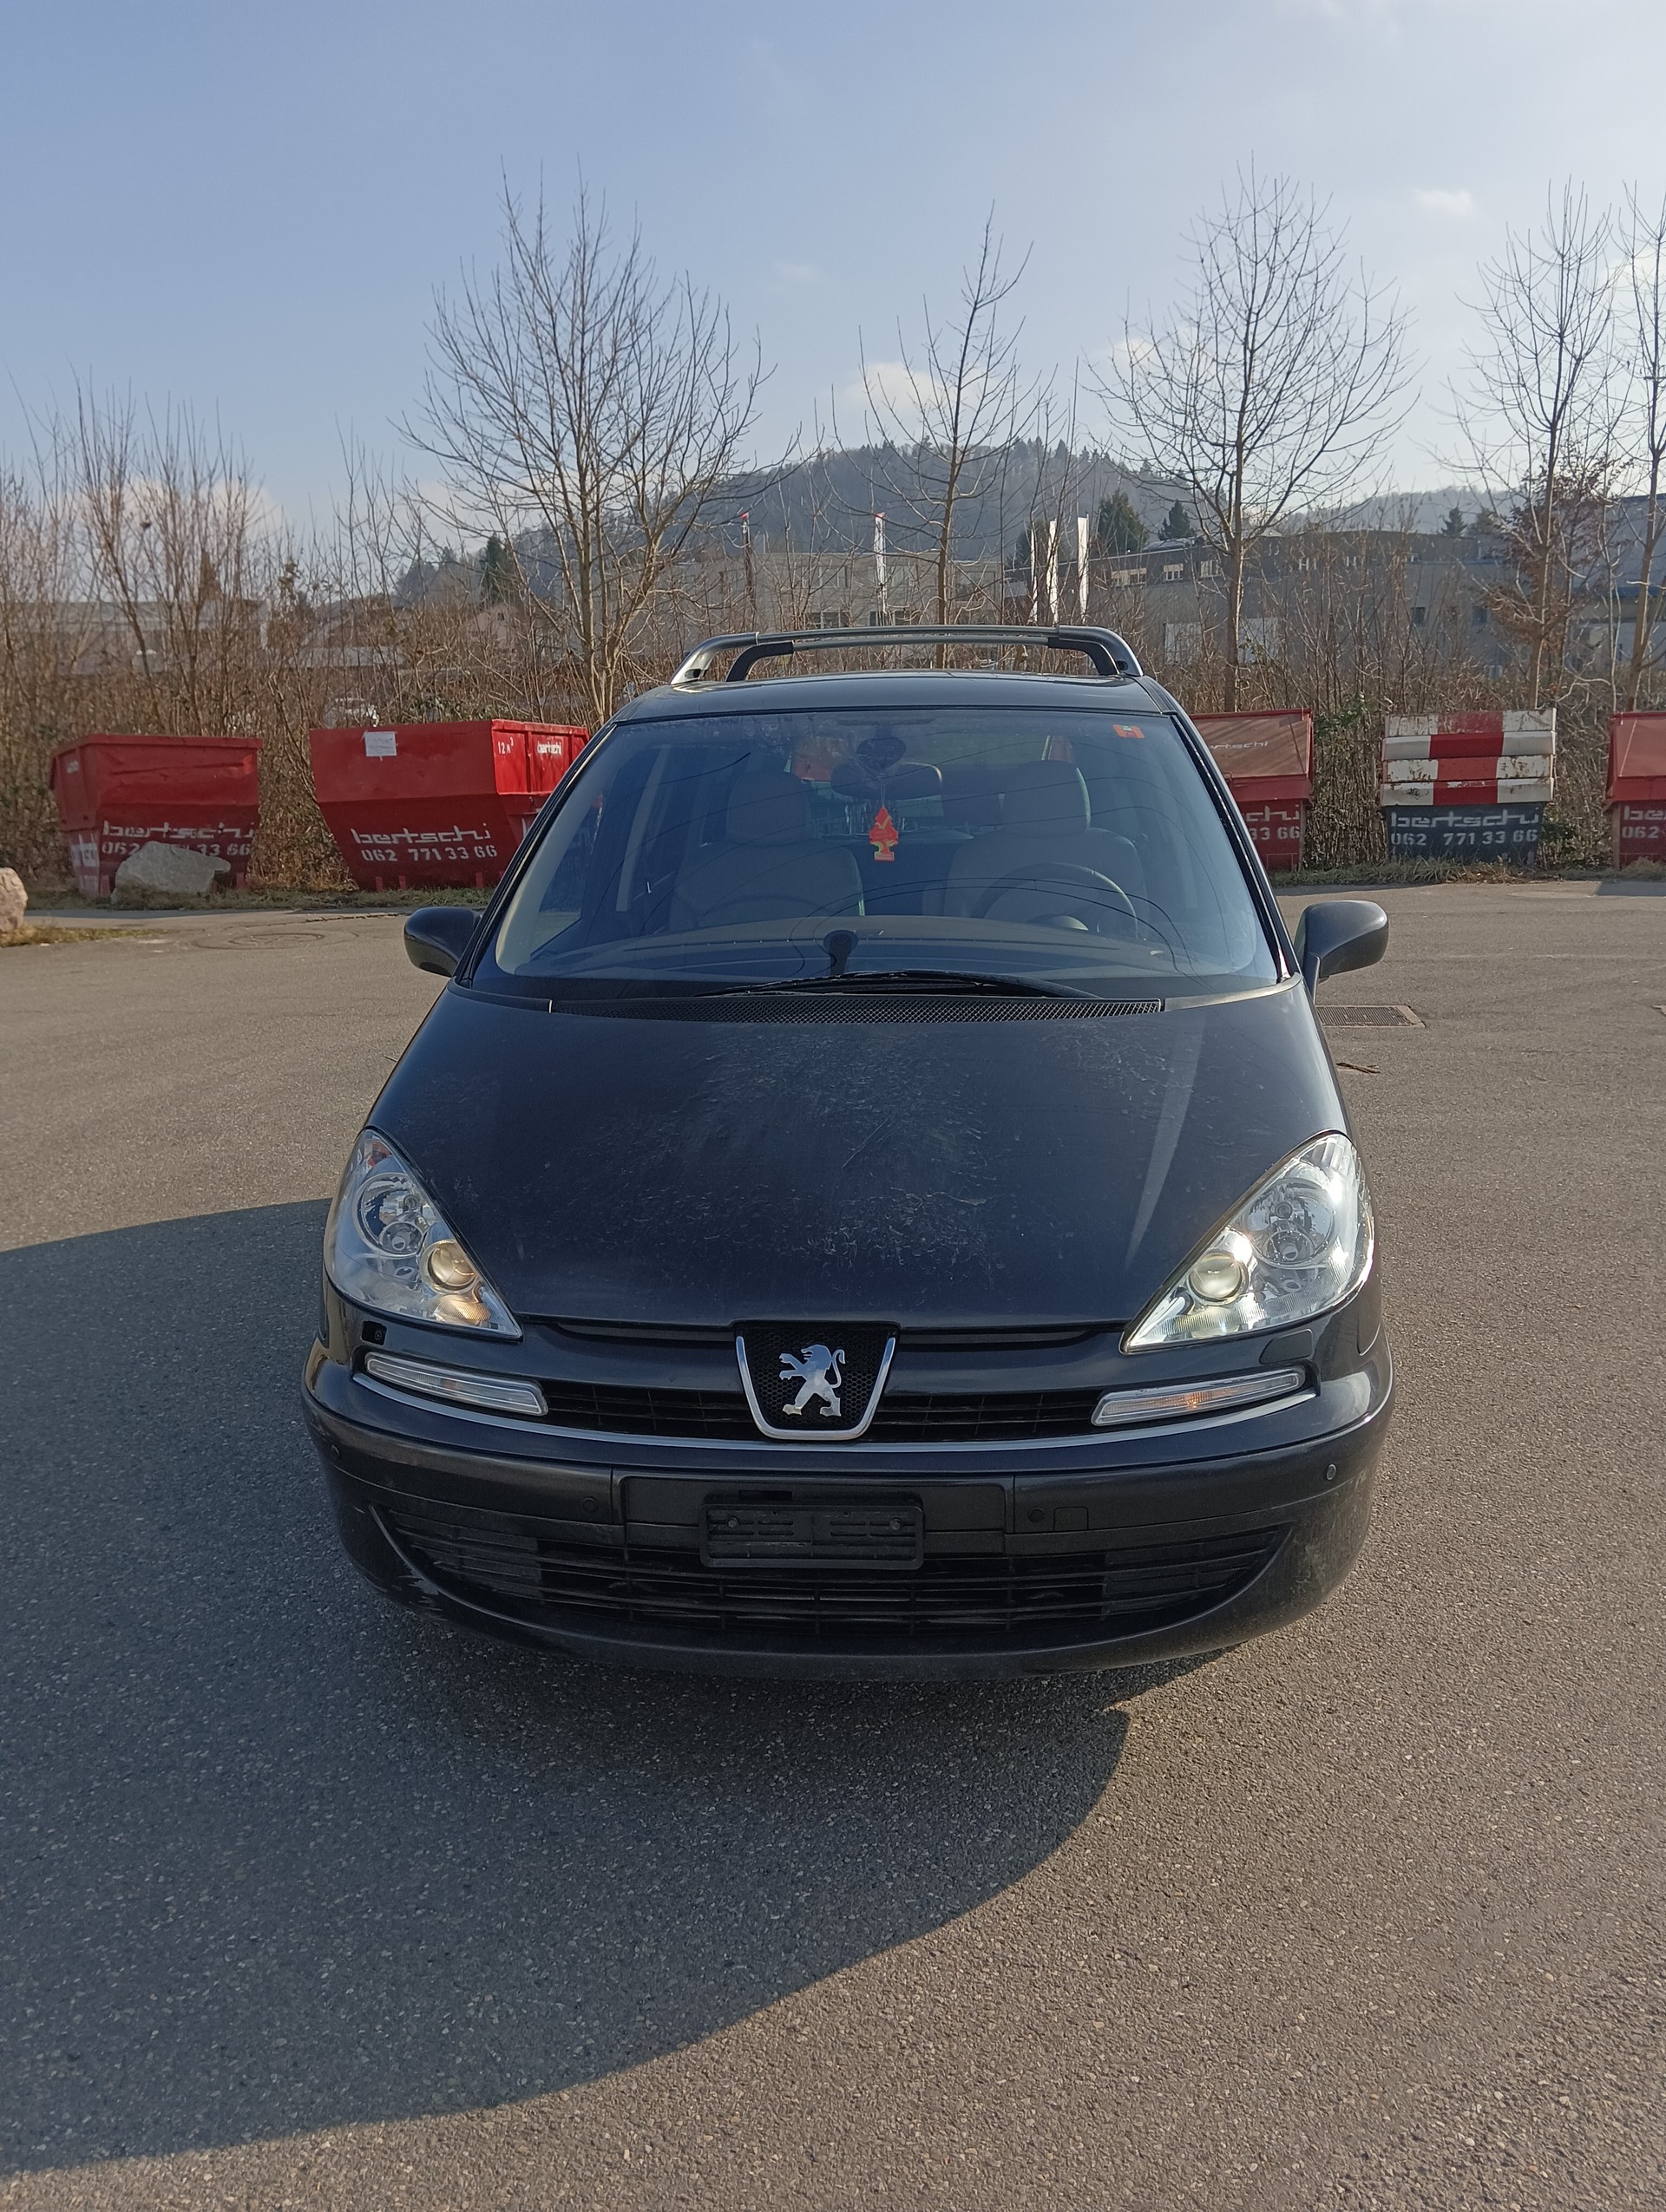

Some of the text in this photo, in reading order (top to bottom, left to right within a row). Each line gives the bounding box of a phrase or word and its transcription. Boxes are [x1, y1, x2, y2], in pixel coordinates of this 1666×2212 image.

[1391, 807, 1539, 828] bertschi
[102, 821, 254, 838] bertschi
[351, 822, 492, 845] bertschi
[1276, 825, 1300, 840] 66
[1391, 828, 1538, 846] 062 771 33 66
[1622, 825, 1660, 839] 062
[102, 841, 141, 854] 062
[226, 843, 252, 856] 66
[361, 844, 498, 862] 062 771 33 66
